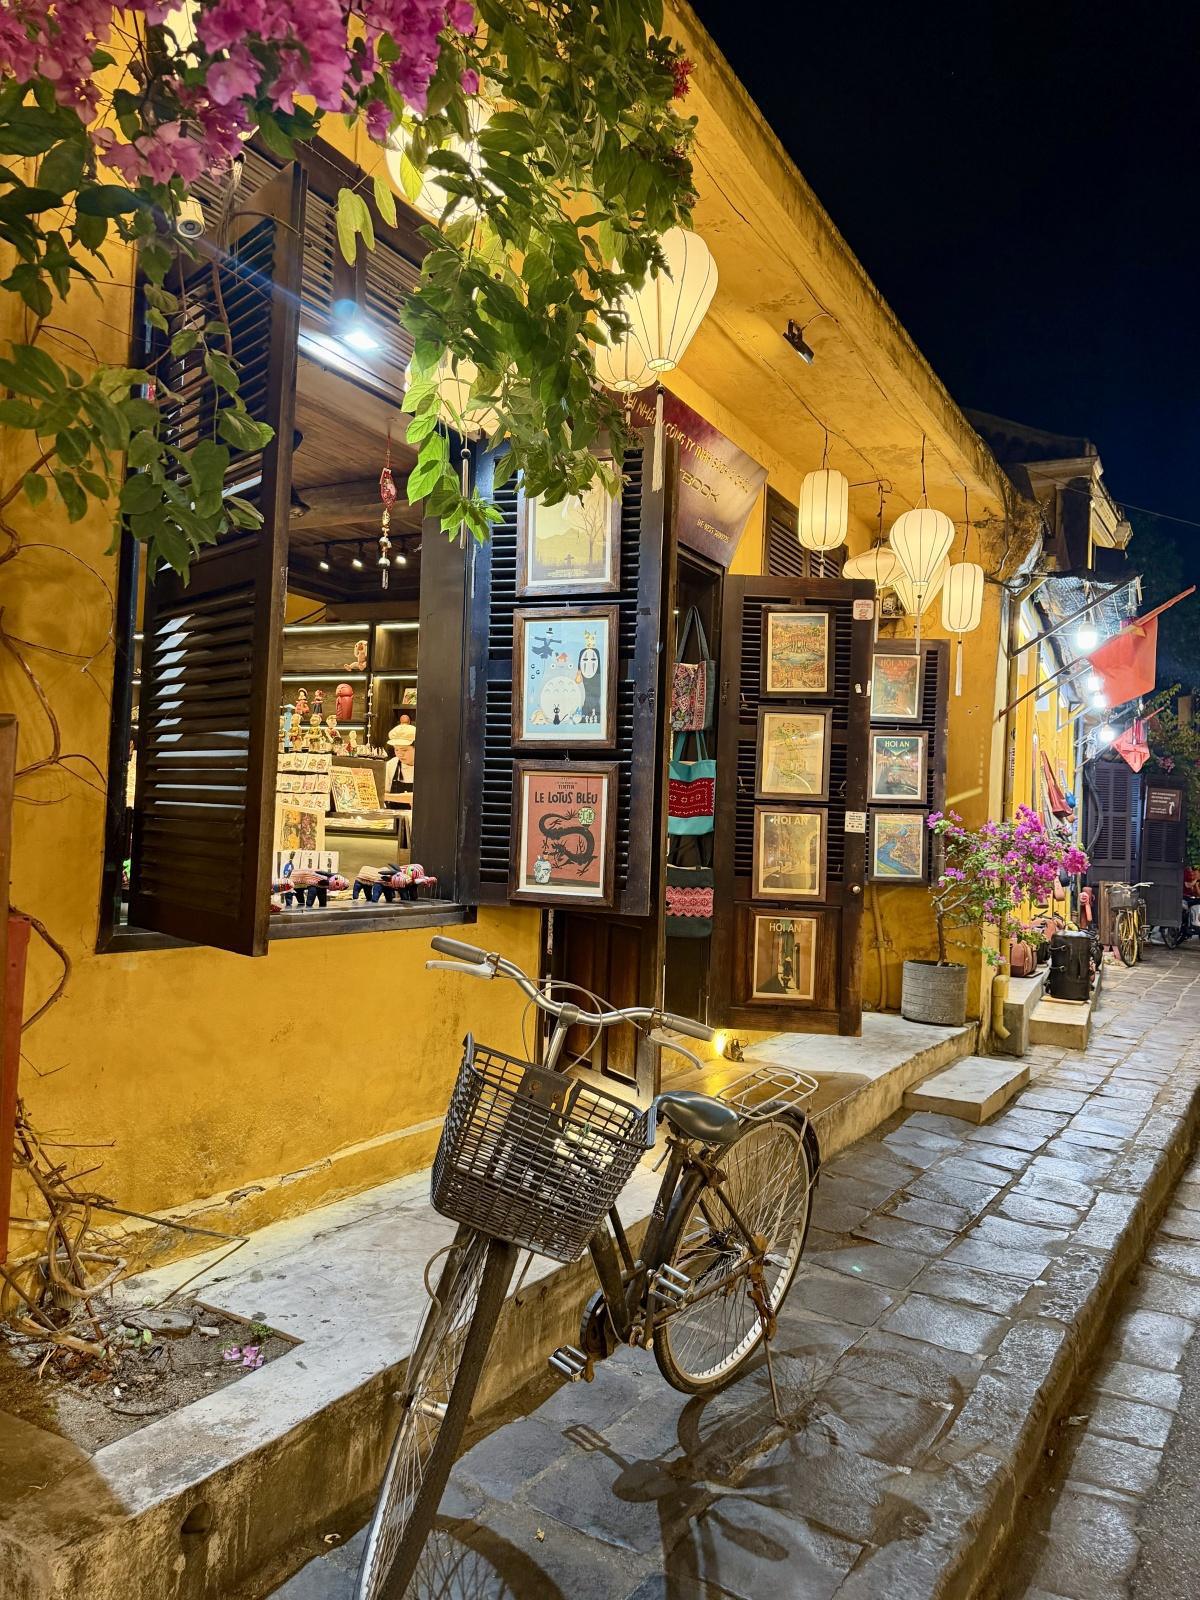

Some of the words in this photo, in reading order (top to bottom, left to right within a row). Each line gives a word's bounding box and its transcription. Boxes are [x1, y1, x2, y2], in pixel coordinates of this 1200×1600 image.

[685, 437, 696, 452] TY
[899, 740, 910, 748] AN
[535, 791, 544, 804] LE
[576, 792, 598, 805] BLEU
[794, 816, 808, 826] AN
[769, 922, 785, 933] HOI
[787, 923, 802, 933] AN
